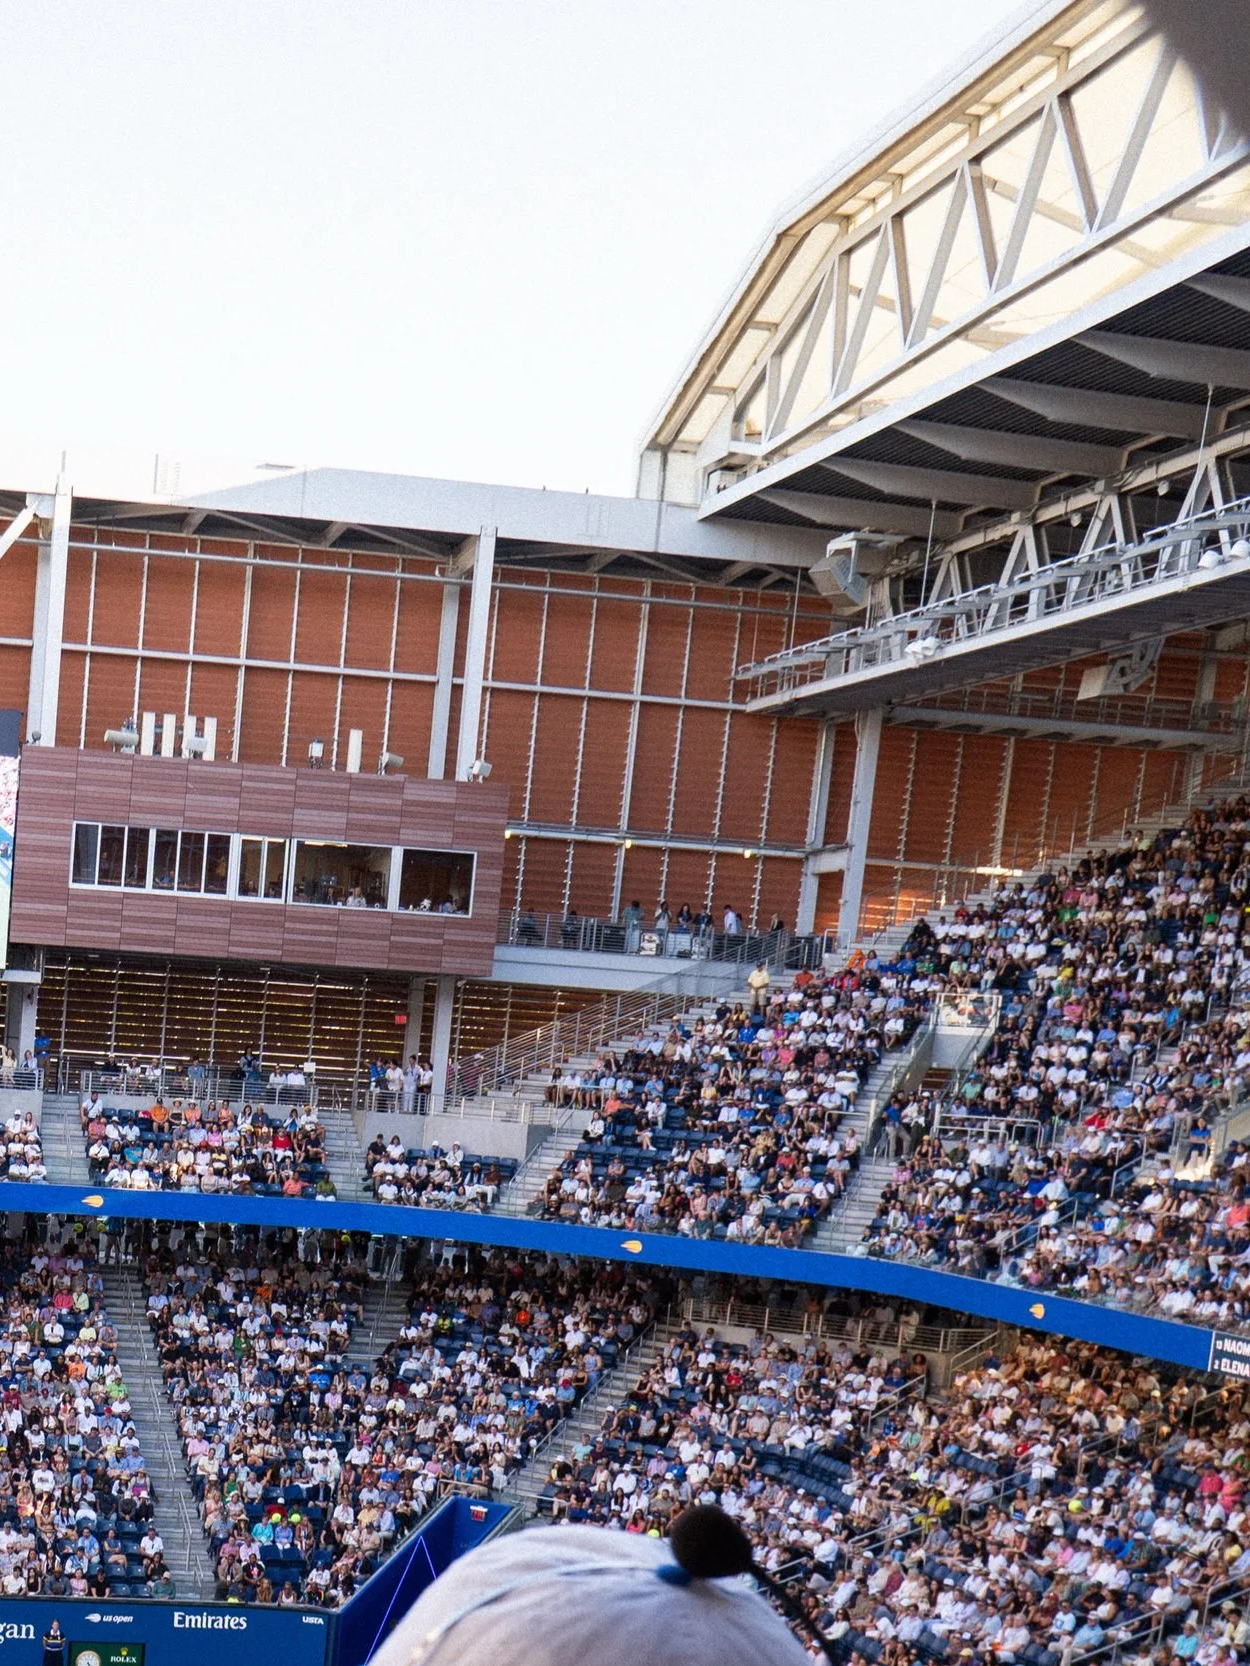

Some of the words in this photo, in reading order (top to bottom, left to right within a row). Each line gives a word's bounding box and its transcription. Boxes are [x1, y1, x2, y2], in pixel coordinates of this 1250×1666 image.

[1214, 1360, 1220, 1370] 2
[1221, 1358, 1250, 1376] ELENA
[102, 1614, 113, 1622] us
[113, 1615, 134, 1624] open
[173, 1611, 248, 1630] Emirates
[302, 1615, 324, 1625] USTA
[110, 1655, 137, 1664] ROLEX
